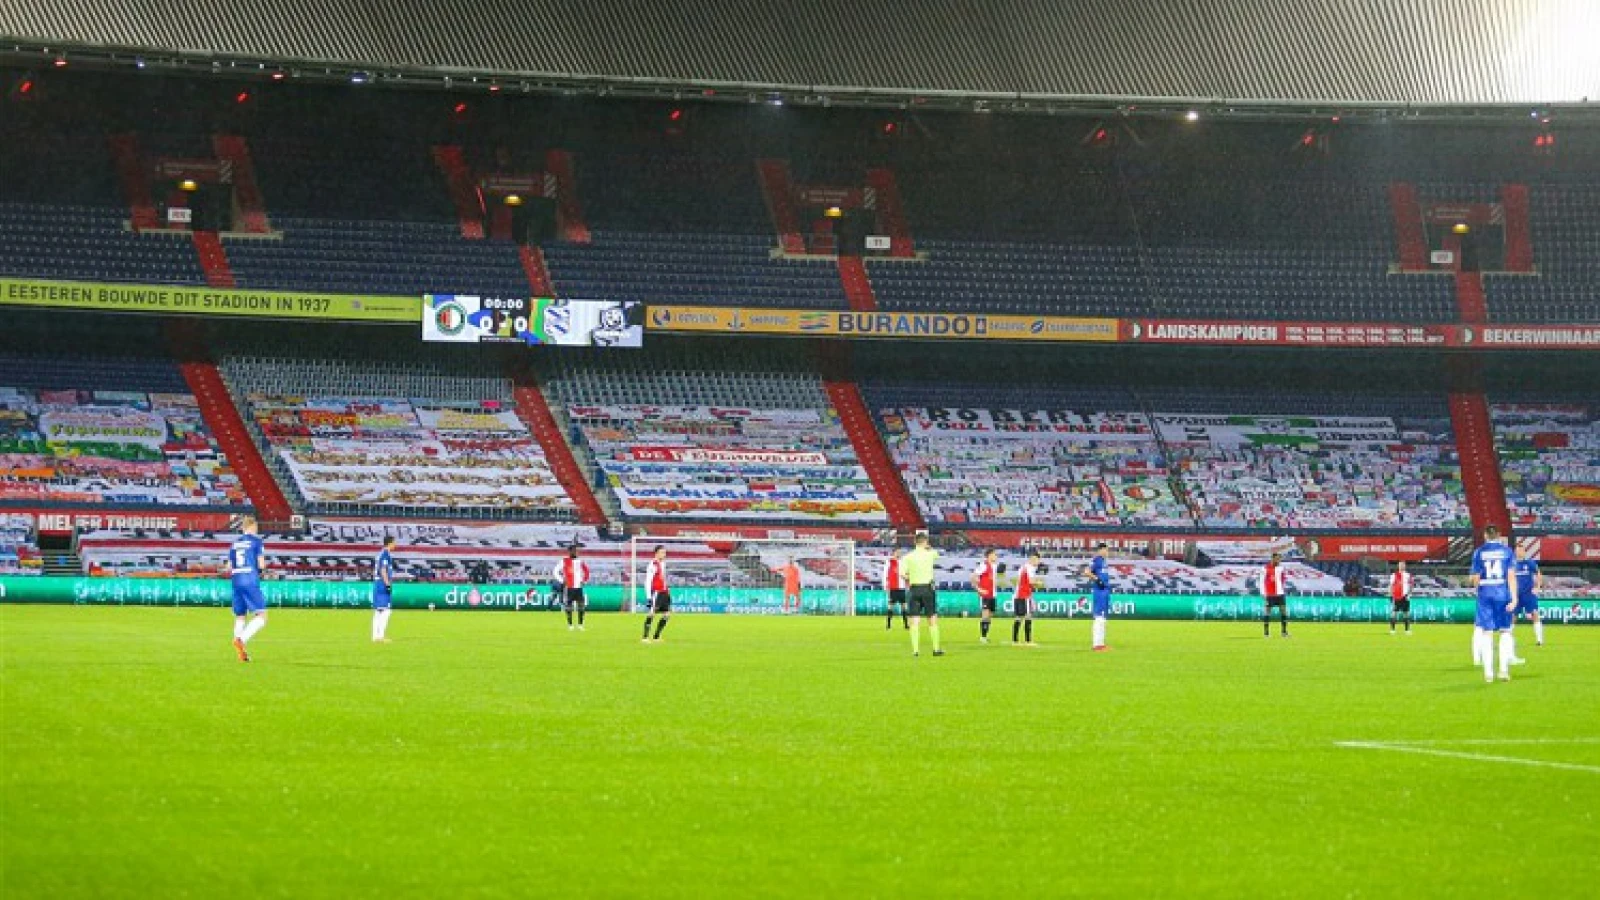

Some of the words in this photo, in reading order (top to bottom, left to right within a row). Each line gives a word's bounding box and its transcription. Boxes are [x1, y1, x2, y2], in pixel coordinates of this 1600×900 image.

[8, 283, 92, 302] EESTEREN
[98, 288, 168, 306] BOUWDE
[173, 292, 199, 307] DIT
[203, 294, 271, 309] STADION
[276, 298, 292, 311] IN
[297, 298, 330, 312] 1937
[838, 312, 970, 335] BURANDO
[1148, 323, 1278, 342] LANDSKAMPIOEN
[1484, 560, 1503, 578] 14
